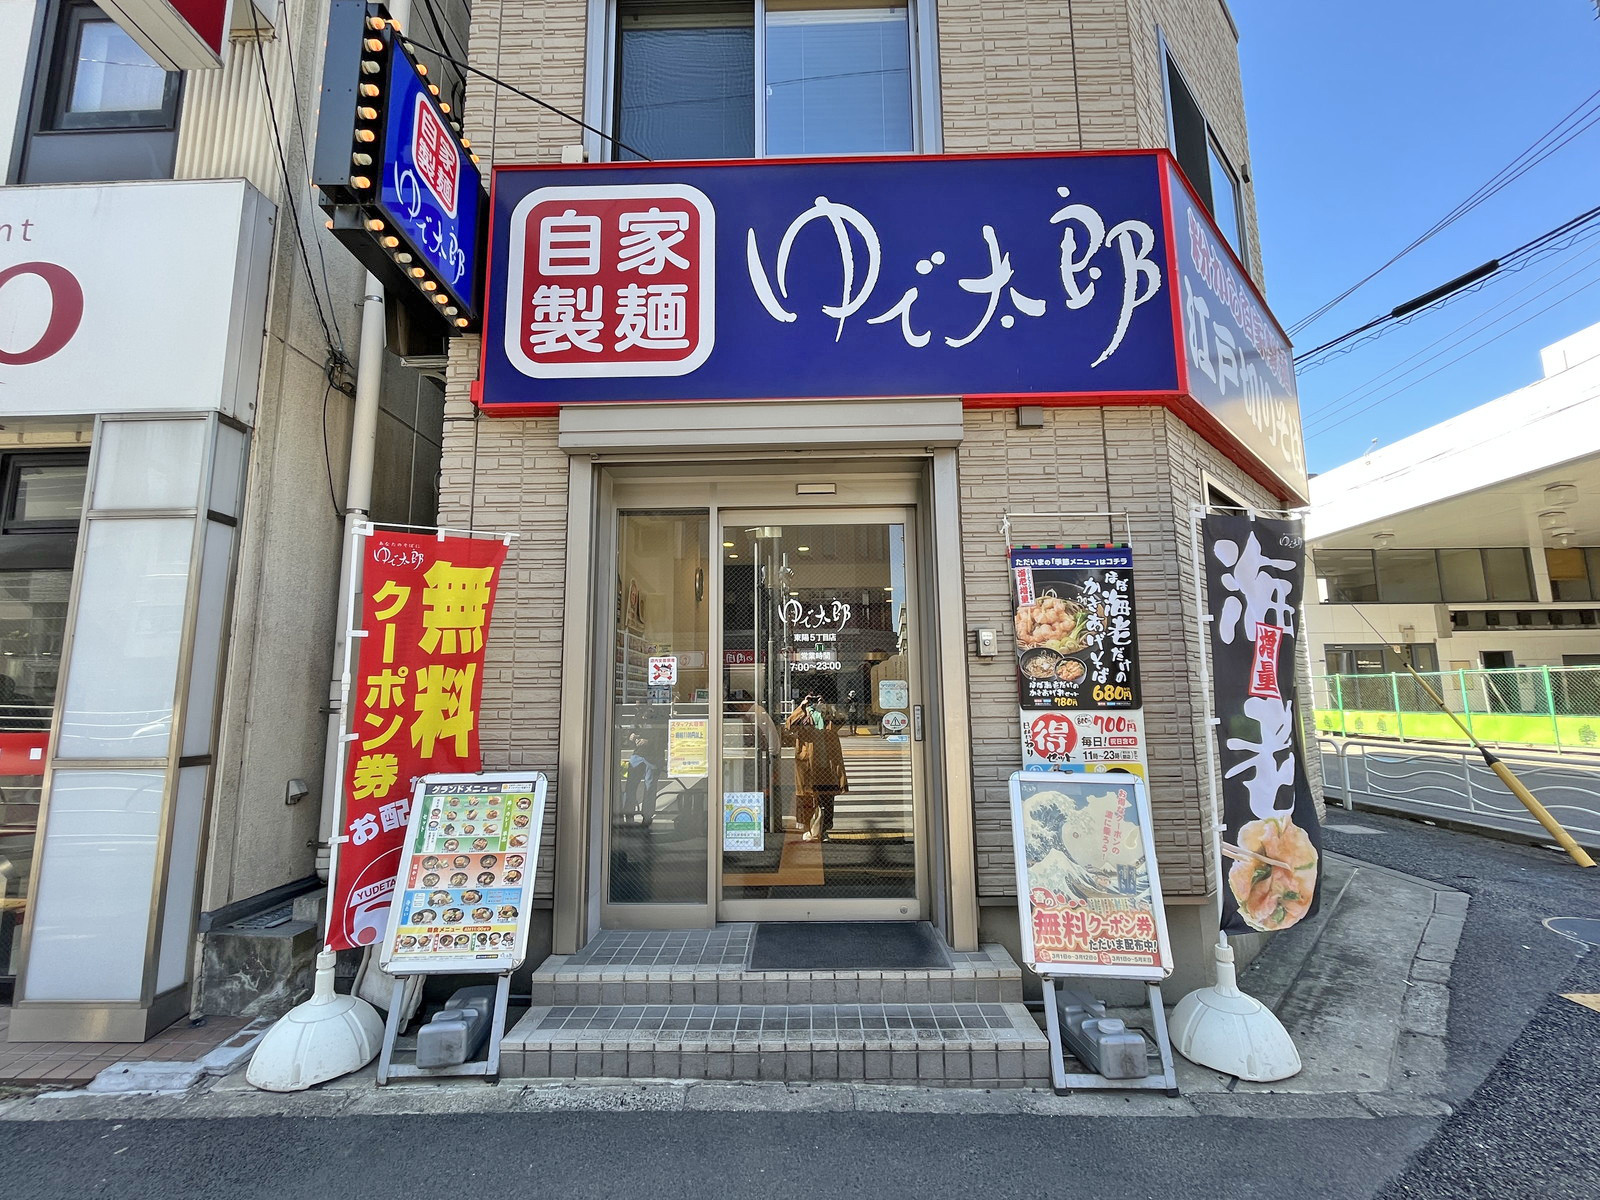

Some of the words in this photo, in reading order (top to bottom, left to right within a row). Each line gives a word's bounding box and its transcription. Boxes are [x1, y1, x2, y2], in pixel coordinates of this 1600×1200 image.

[394, 160, 466, 285] ゆで太郎
[537, 206, 691, 276] 自家
[746, 187, 1161, 368] ゆで太郎
[530, 283, 690, 353] 製麺
[1184, 275, 1304, 476] 江戸切りそば
[373, 547, 424, 570] ゆで太郎
[778, 597, 851, 632] ゆで太郎
[793, 633, 837, 642] 東陽5丁目店
[1083, 577, 1110, 684] かきあげそば
[1102, 570, 1132, 683] ほぼ海老だけの
[410, 560, 495, 759] 無料
[801, 652, 831, 660] 営業時間
[1256, 627, 1279, 692] 増量
[352, 579, 411, 801] クーポン券
[1092, 685, 1133, 702] 680円
[1033, 720, 1070, 753] 得
[1093, 714, 1137, 735] 700円
[431, 785, 498, 794] グランドメニュー
[1033, 890, 1054, 907] 春の
[1034, 910, 1091, 946] 無料
[1089, 914, 1152, 937] クーポン券
